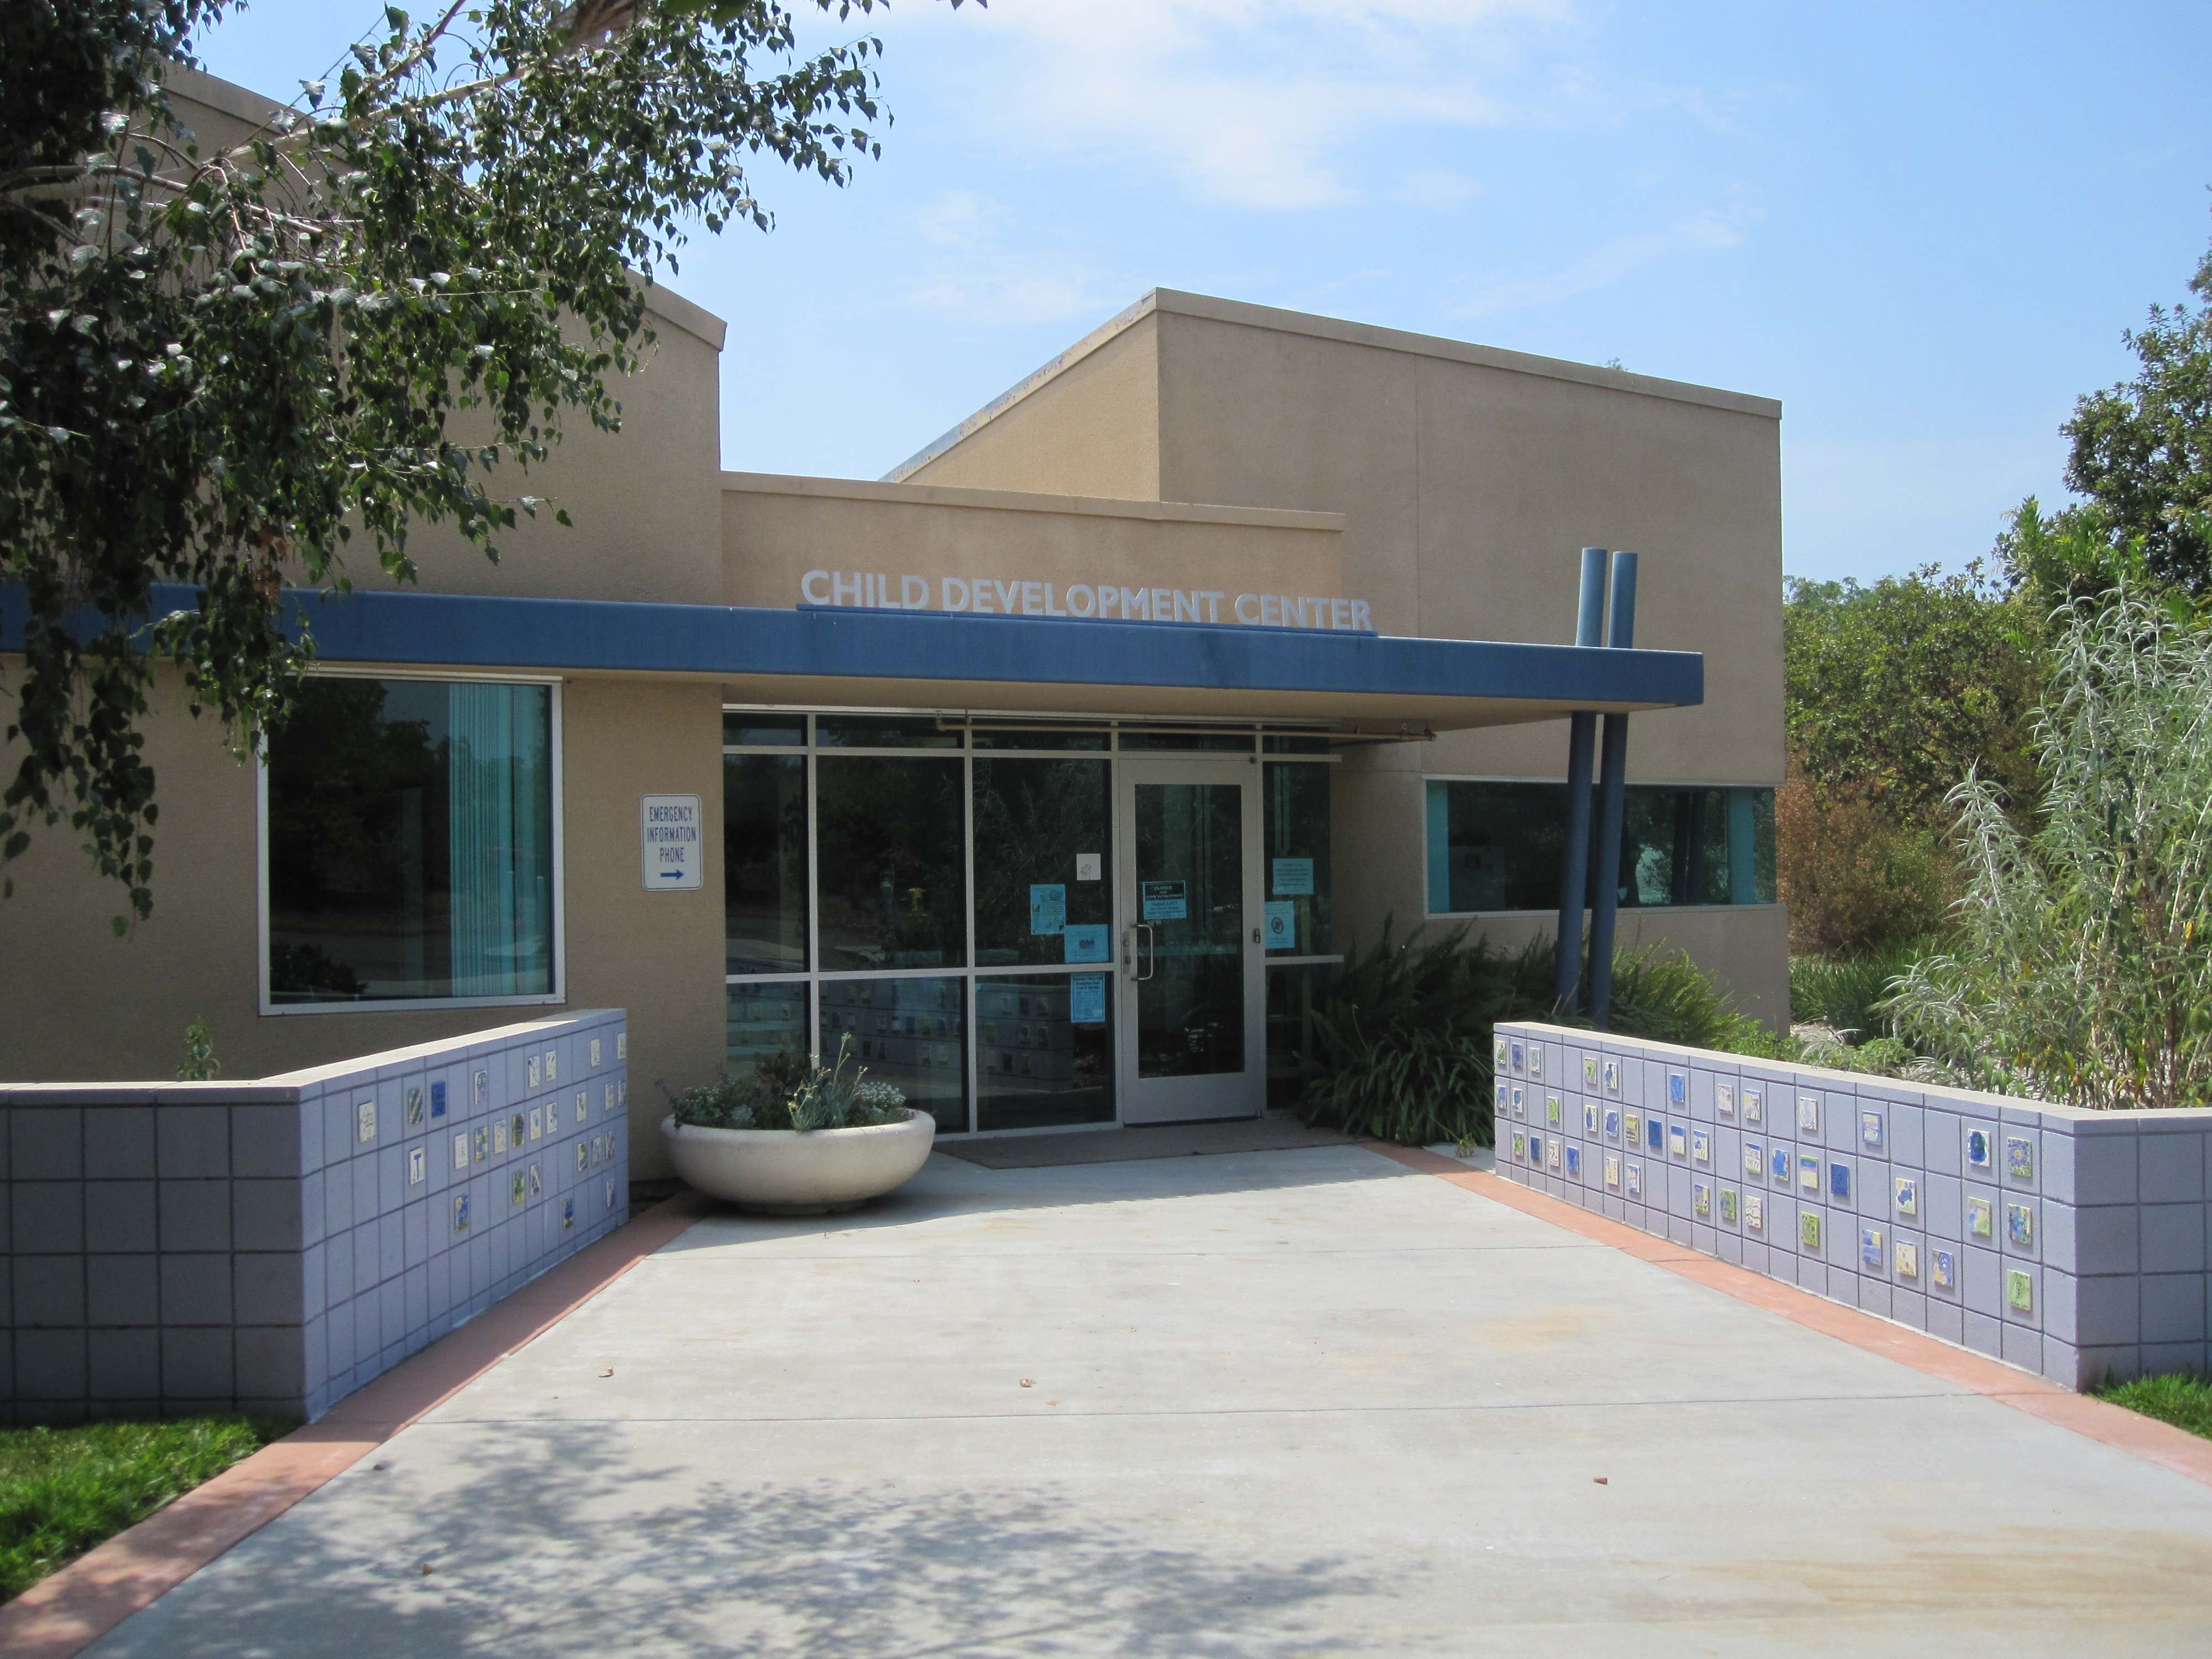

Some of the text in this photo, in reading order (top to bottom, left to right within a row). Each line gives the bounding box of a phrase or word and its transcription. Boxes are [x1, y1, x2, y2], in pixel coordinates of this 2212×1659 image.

[801, 570, 1373, 631] CHILD DEVELOPMENT CENTER
[649, 806, 692, 822] EMERGENCY
[647, 827, 696, 842] INFORMATION
[660, 847, 685, 862] PHONE
